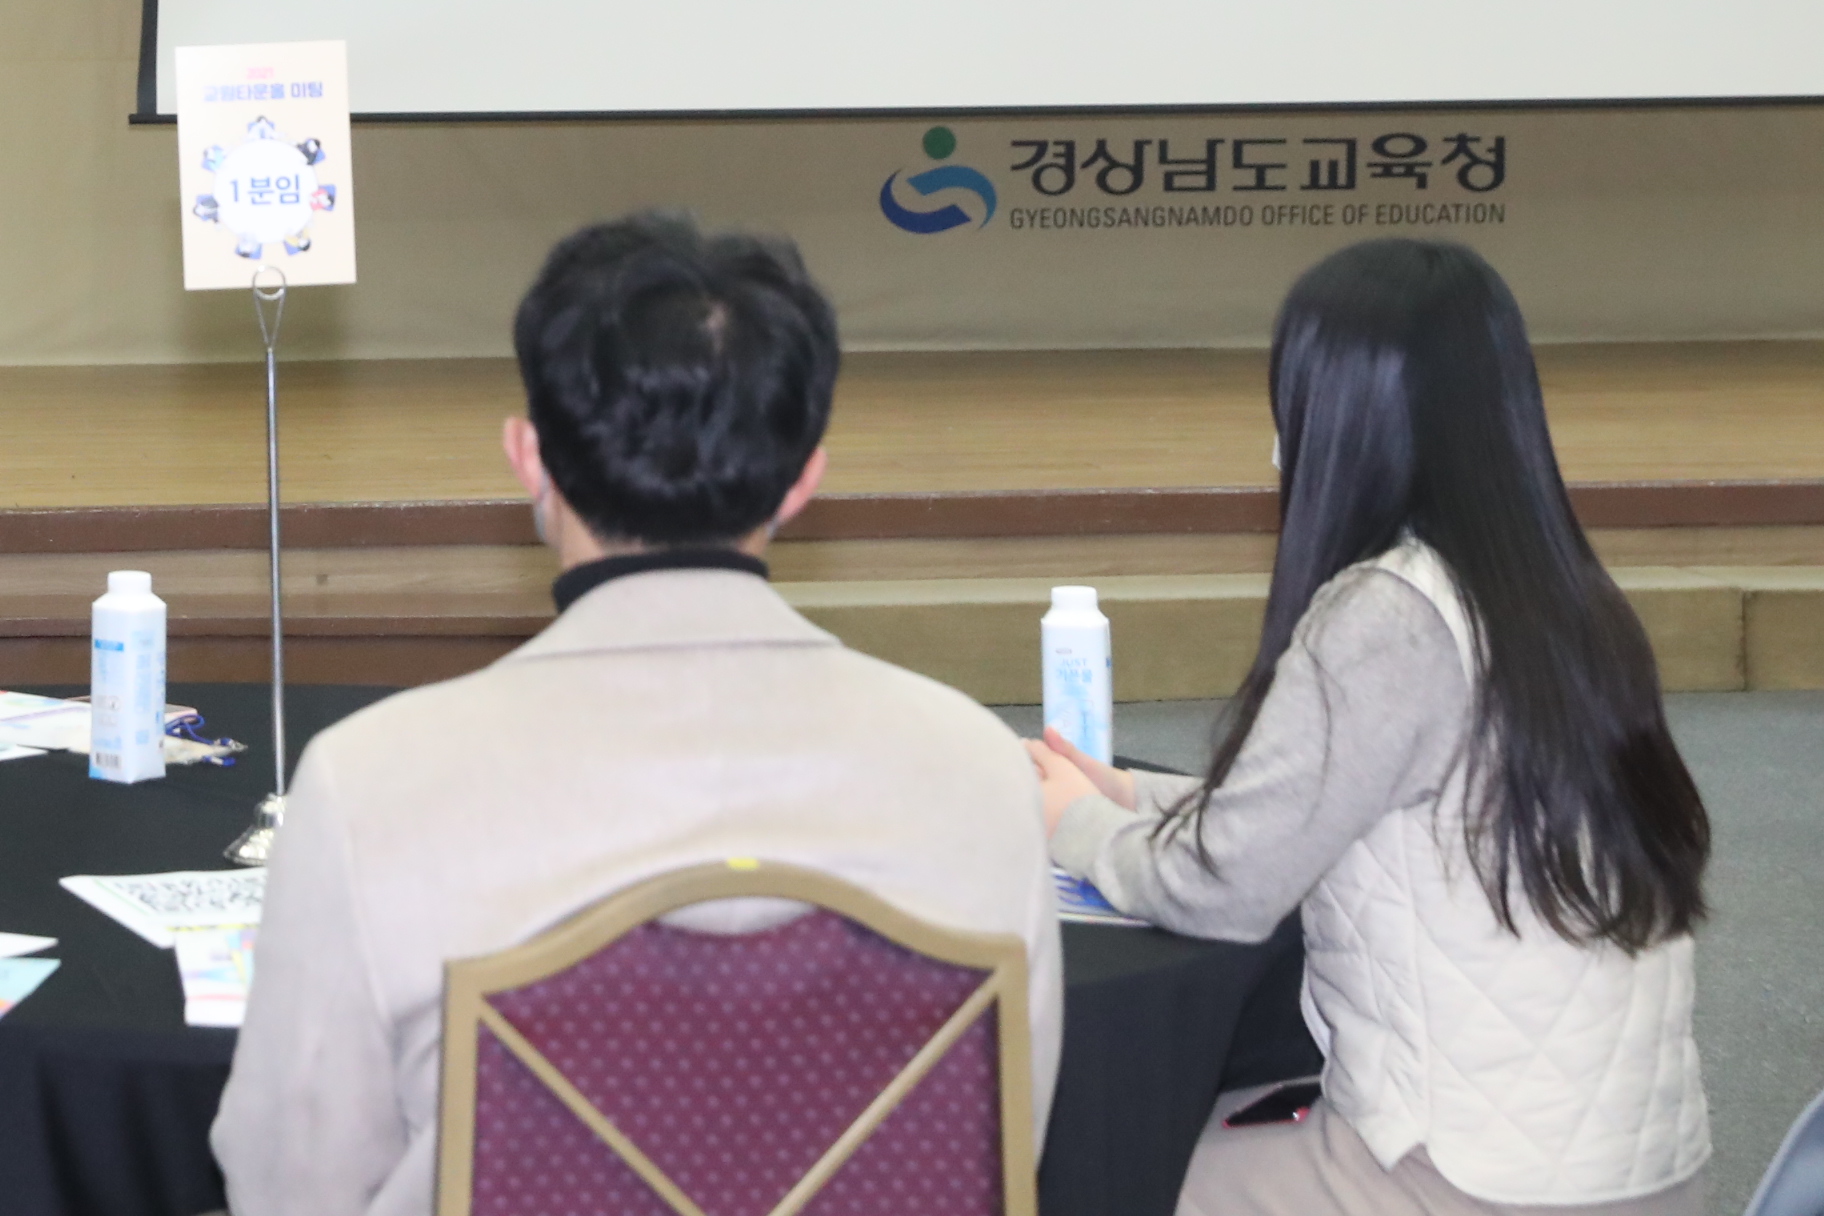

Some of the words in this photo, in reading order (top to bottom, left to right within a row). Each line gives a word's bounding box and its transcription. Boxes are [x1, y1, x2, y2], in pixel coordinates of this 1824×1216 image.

[1010, 132, 1508, 197] 경상남도교육청
[247, 174, 300, 205] 분임
[1010, 205, 1254, 230] GYEONGSANGNAMDO
[1261, 204, 1336, 228] OFFICE
[1342, 204, 1370, 227] OF
[1375, 203, 1507, 227] EDUCATION
